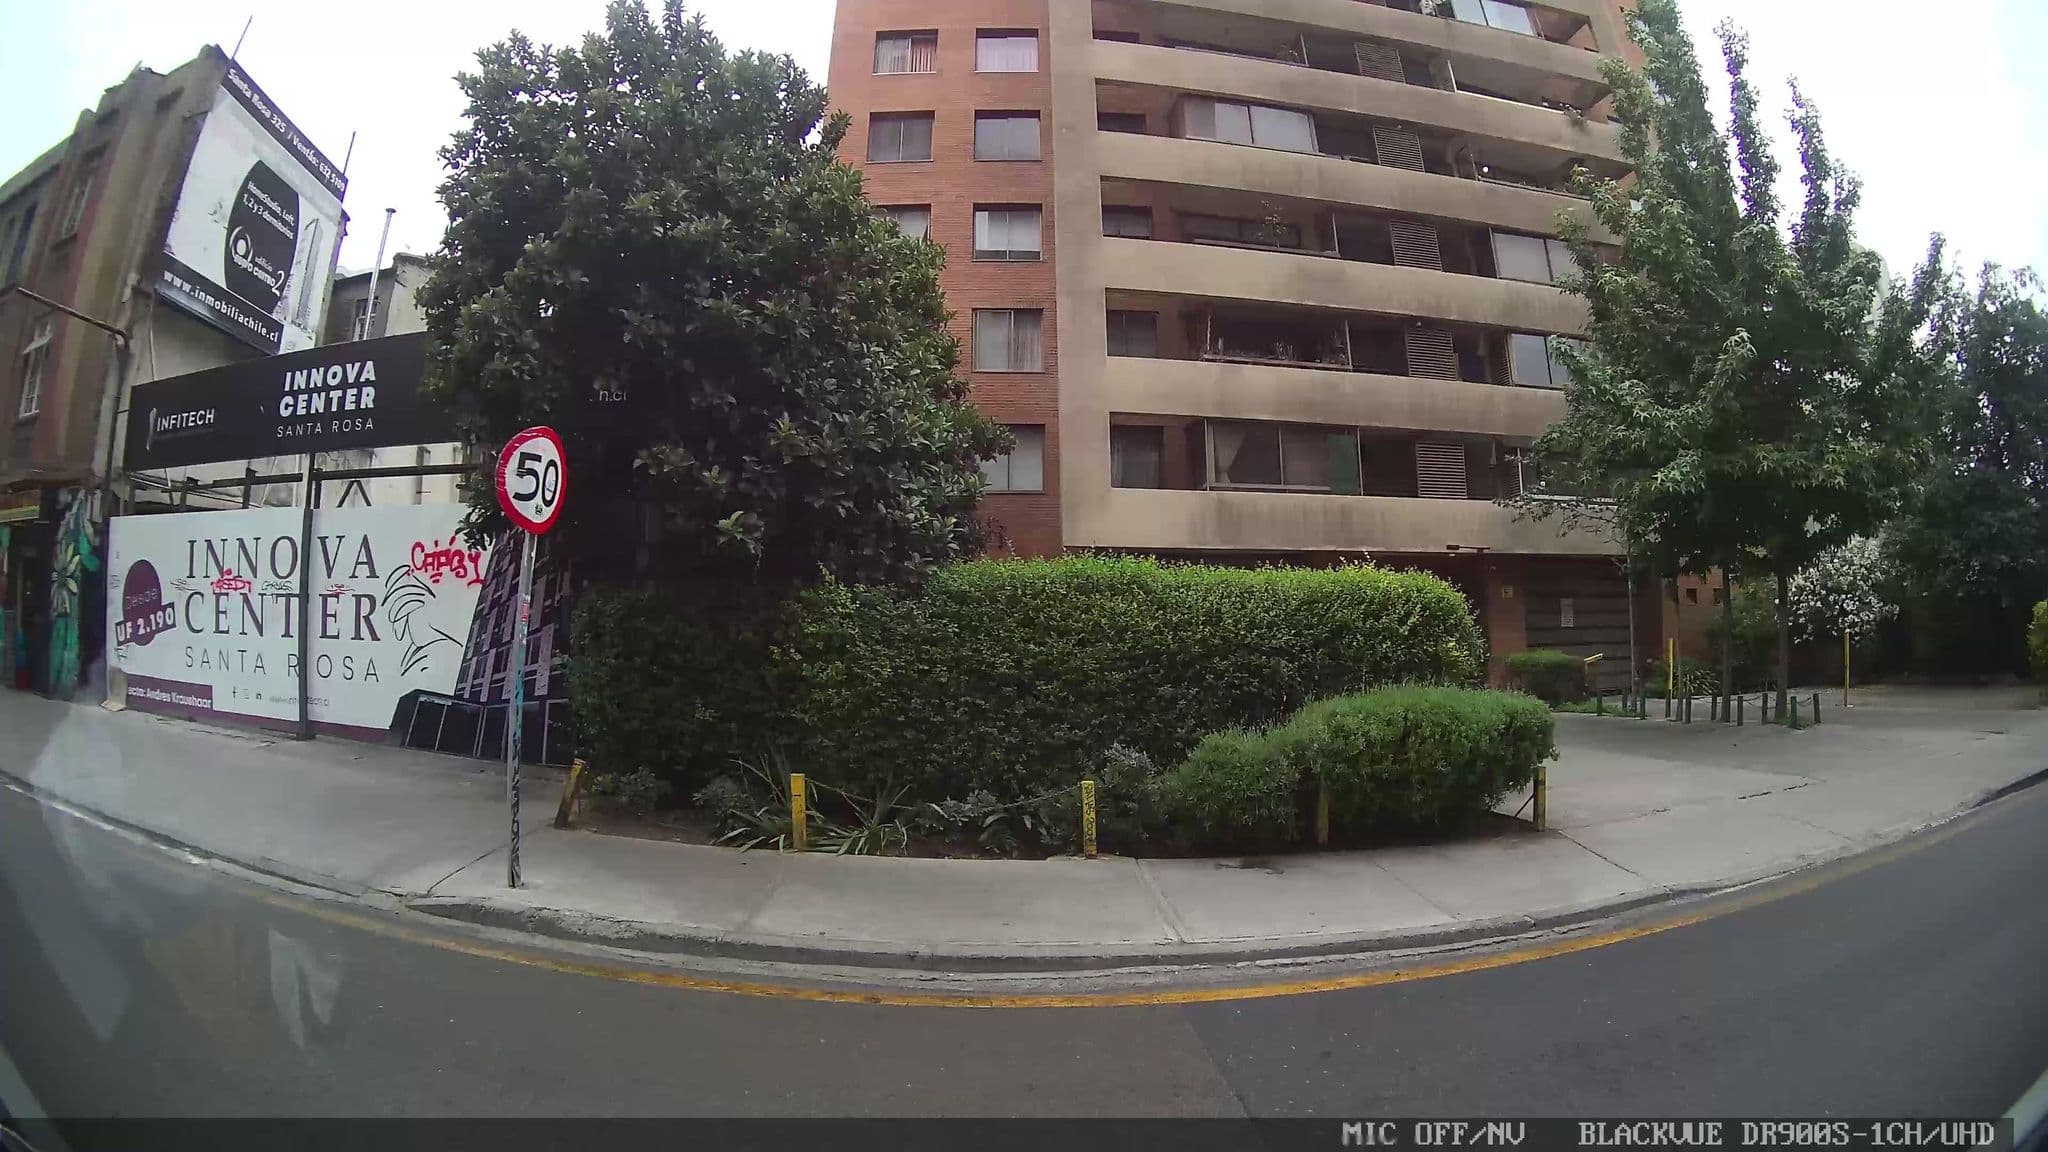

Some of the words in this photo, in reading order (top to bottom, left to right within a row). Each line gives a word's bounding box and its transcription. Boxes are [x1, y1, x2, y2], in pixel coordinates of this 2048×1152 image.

[228, 69, 252, 98] Santa
[251, 93, 271, 118] Rosa
[271, 114, 286, 132] 325
[163, 270, 279, 342] www.inmobiliachile.cl
[284, 360, 377, 391] INNOVA
[156, 408, 215, 432] INFITECH
[279, 386, 376, 417] CENTER
[276, 423, 322, 438] SANTA
[331, 417, 374, 433] ROSA
[511, 451, 559, 508] 50
[186, 534, 380, 580] INNOVA
[116, 621, 133, 642] UF
[137, 607, 175, 635] 2.190
[184, 591, 381, 642] CENTER
[185, 646, 266, 675] SANTA
[287, 653, 380, 683] ROSA
